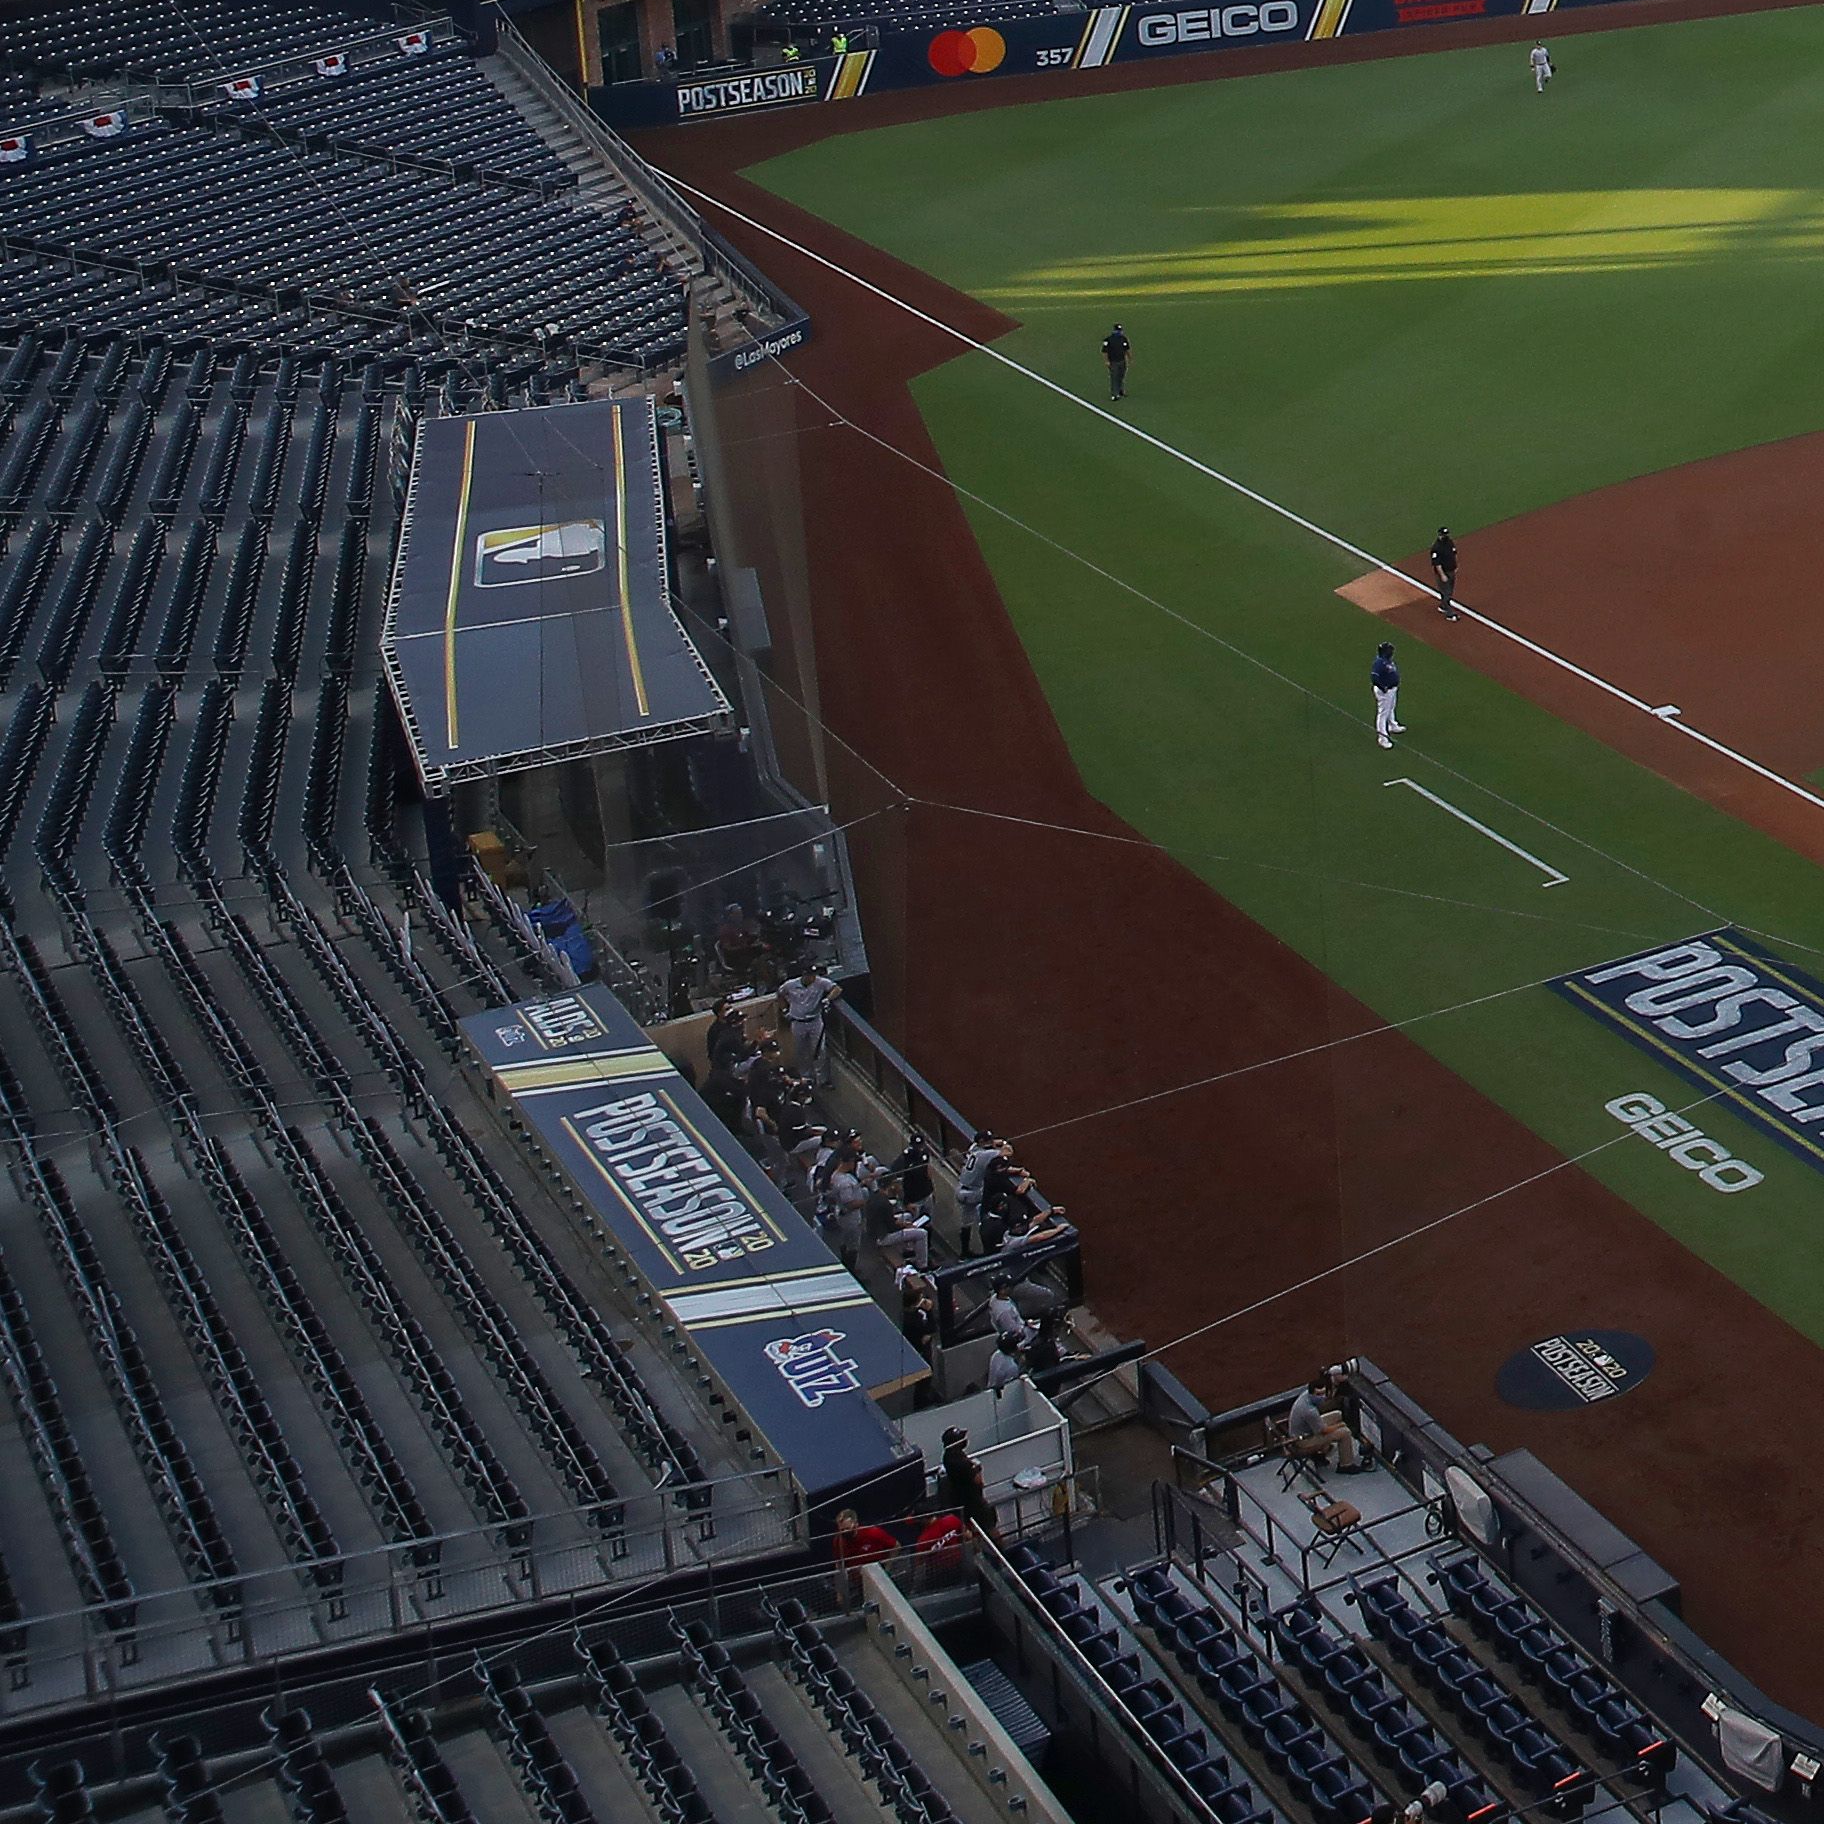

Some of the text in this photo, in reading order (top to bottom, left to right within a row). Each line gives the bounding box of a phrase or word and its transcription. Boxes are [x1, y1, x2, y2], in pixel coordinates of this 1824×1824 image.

[1137, 0, 1300, 48] GEICO
[1036, 47, 1074, 68] 357
[677, 69, 803, 114] POSTSEASON
[524, 997, 595, 1038] ALDS
[1604, 1092, 1765, 1194] GEICO
[572, 1093, 759, 1261] POSTSEASON
[1533, 1337, 1616, 1403] POSTSEASON
